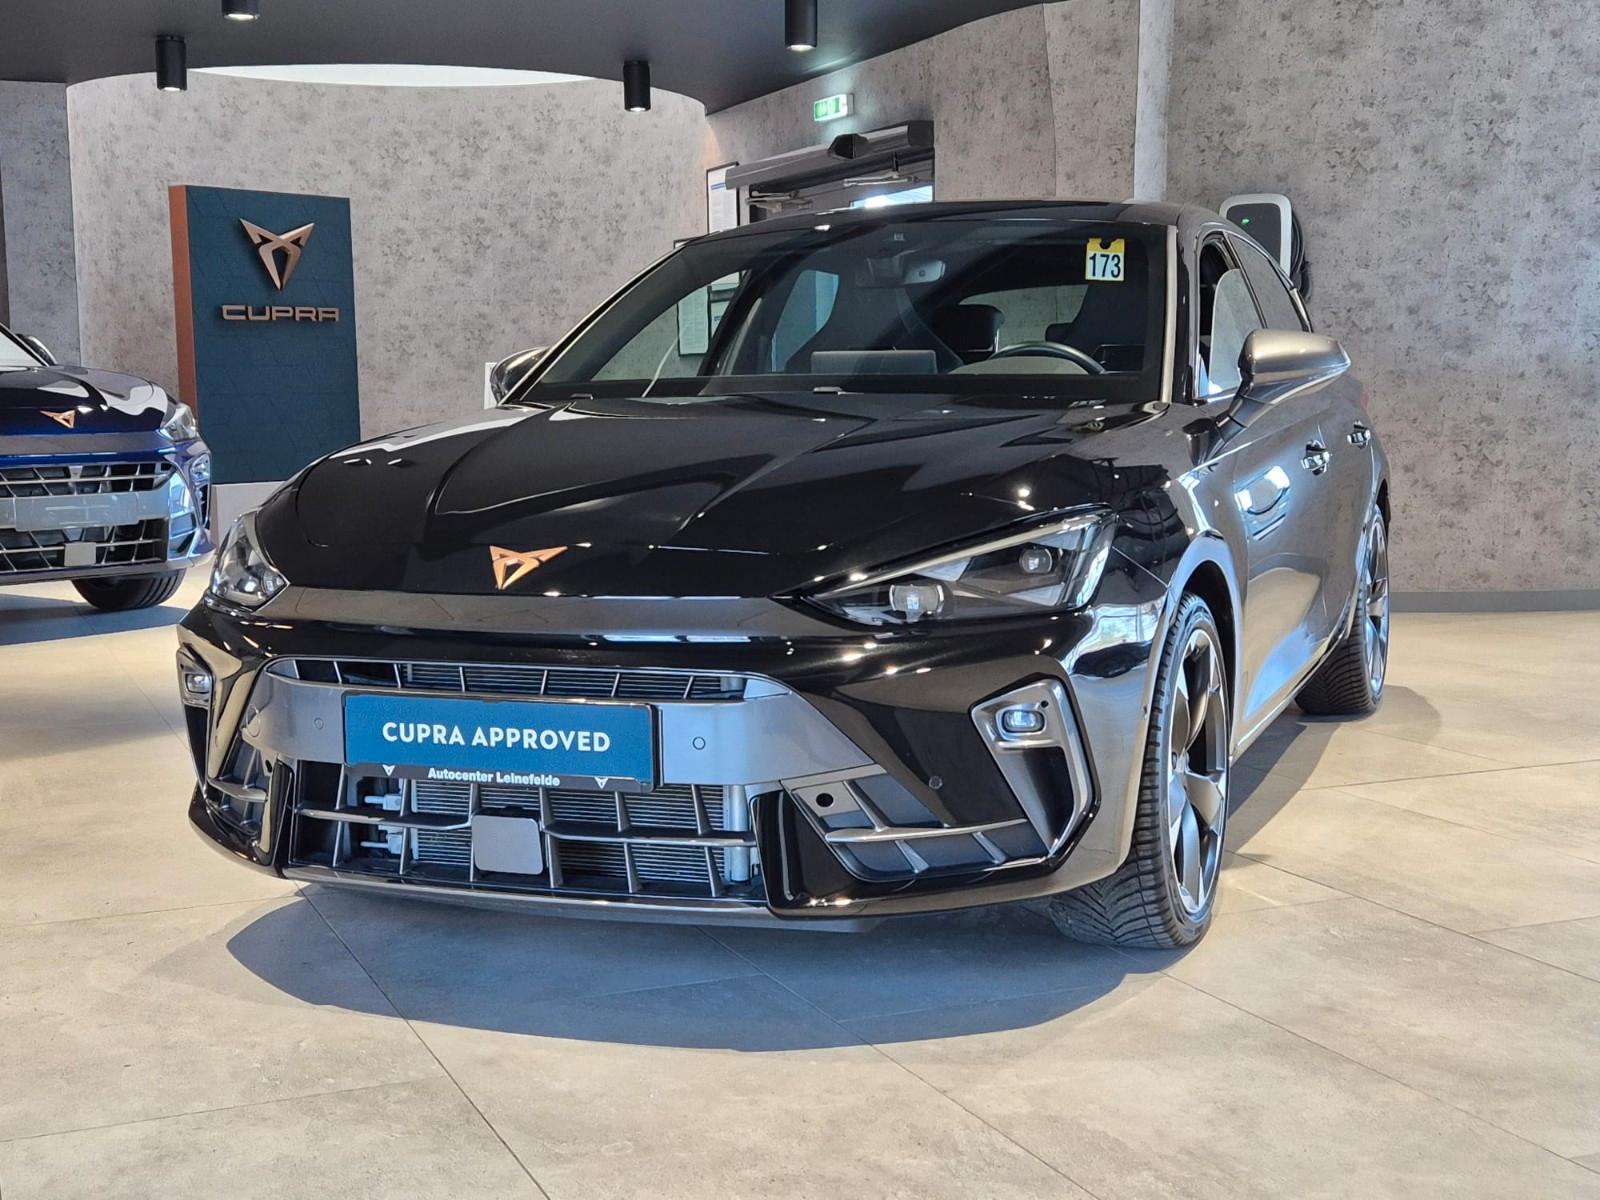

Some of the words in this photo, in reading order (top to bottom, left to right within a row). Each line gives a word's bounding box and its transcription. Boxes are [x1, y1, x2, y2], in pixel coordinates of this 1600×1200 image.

[1089, 253, 1121, 278] 173
[221, 304, 340, 322] CUPRA
[382, 722, 466, 746] CUPRA
[472, 727, 610, 752] APPROVED
[427, 767, 494, 782] Autocenter
[496, 772, 561, 786] Leinefelde
